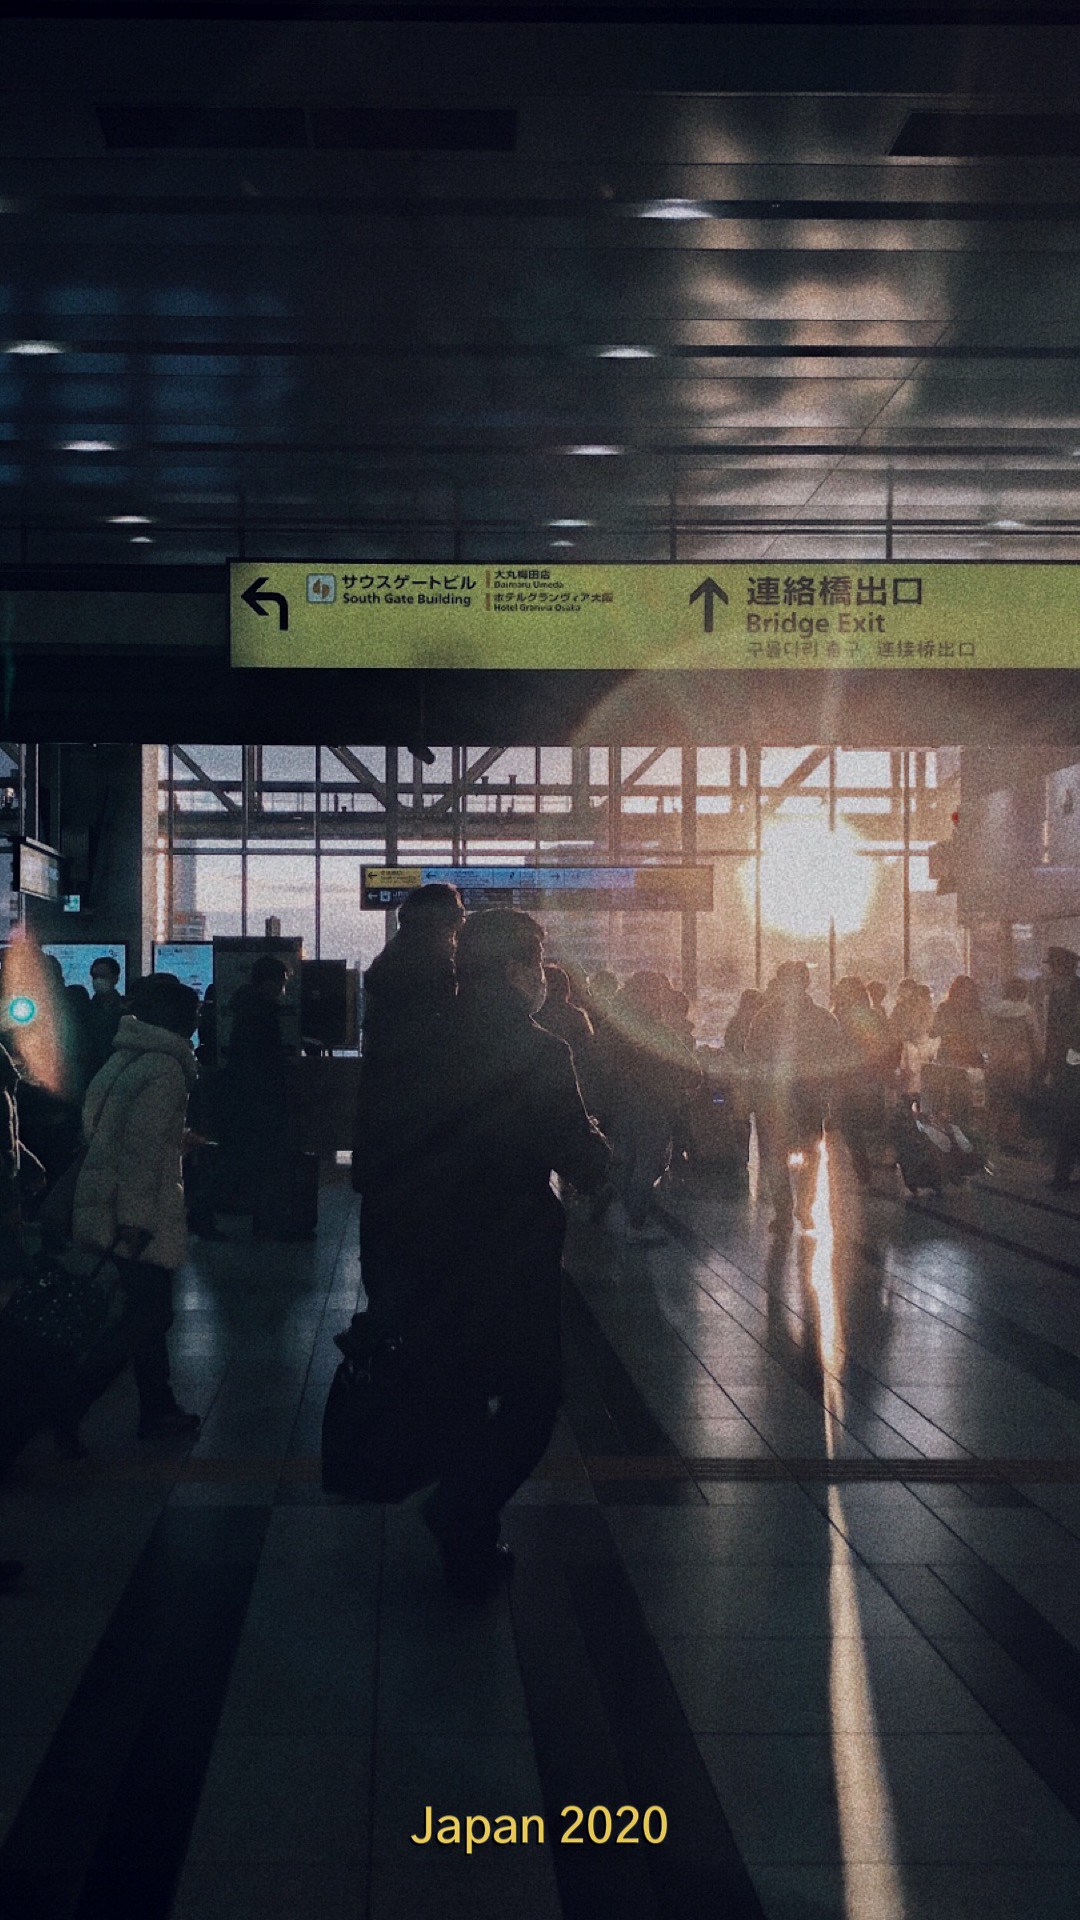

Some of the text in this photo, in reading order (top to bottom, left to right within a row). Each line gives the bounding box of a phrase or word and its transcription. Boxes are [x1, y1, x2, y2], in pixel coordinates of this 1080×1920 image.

[342, 575, 476, 589] サウスゲートビル
[748, 576, 922, 606] 連絡橋出口
[343, 593, 471, 607] South Gate Building
[747, 612, 886, 638] Bridge Exit
